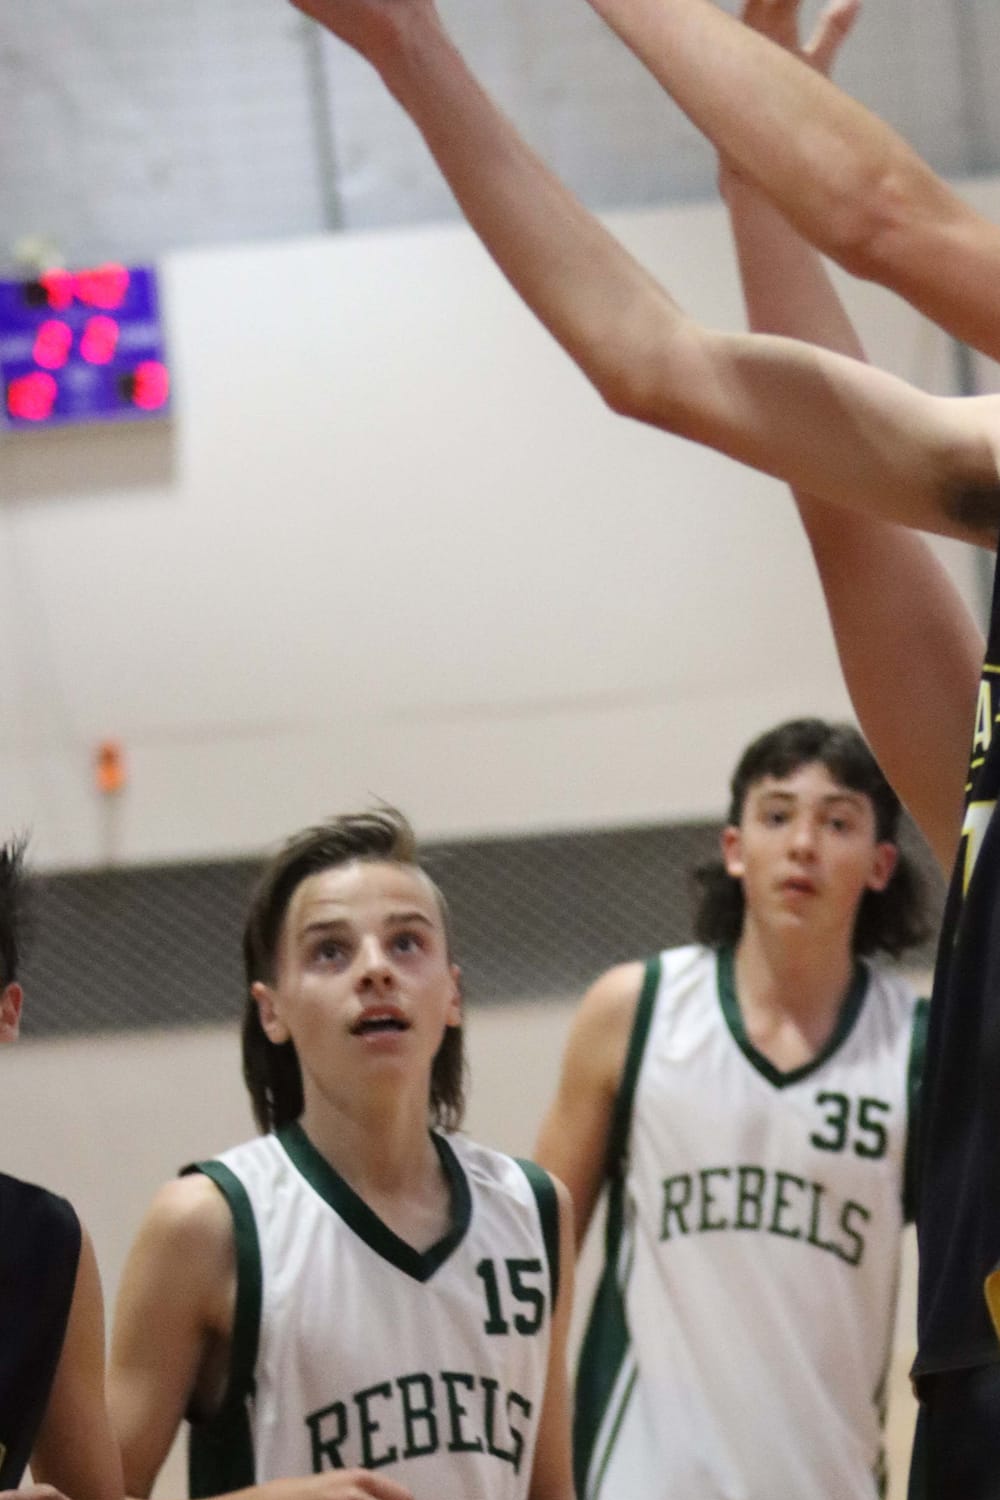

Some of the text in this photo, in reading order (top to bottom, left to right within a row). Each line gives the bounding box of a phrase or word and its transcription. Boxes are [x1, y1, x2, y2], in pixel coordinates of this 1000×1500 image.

[810, 1090, 891, 1161] 35
[659, 1165, 871, 1268] REBELS
[476, 1258, 546, 1336] 15
[305, 1370, 533, 1476] REBELS
